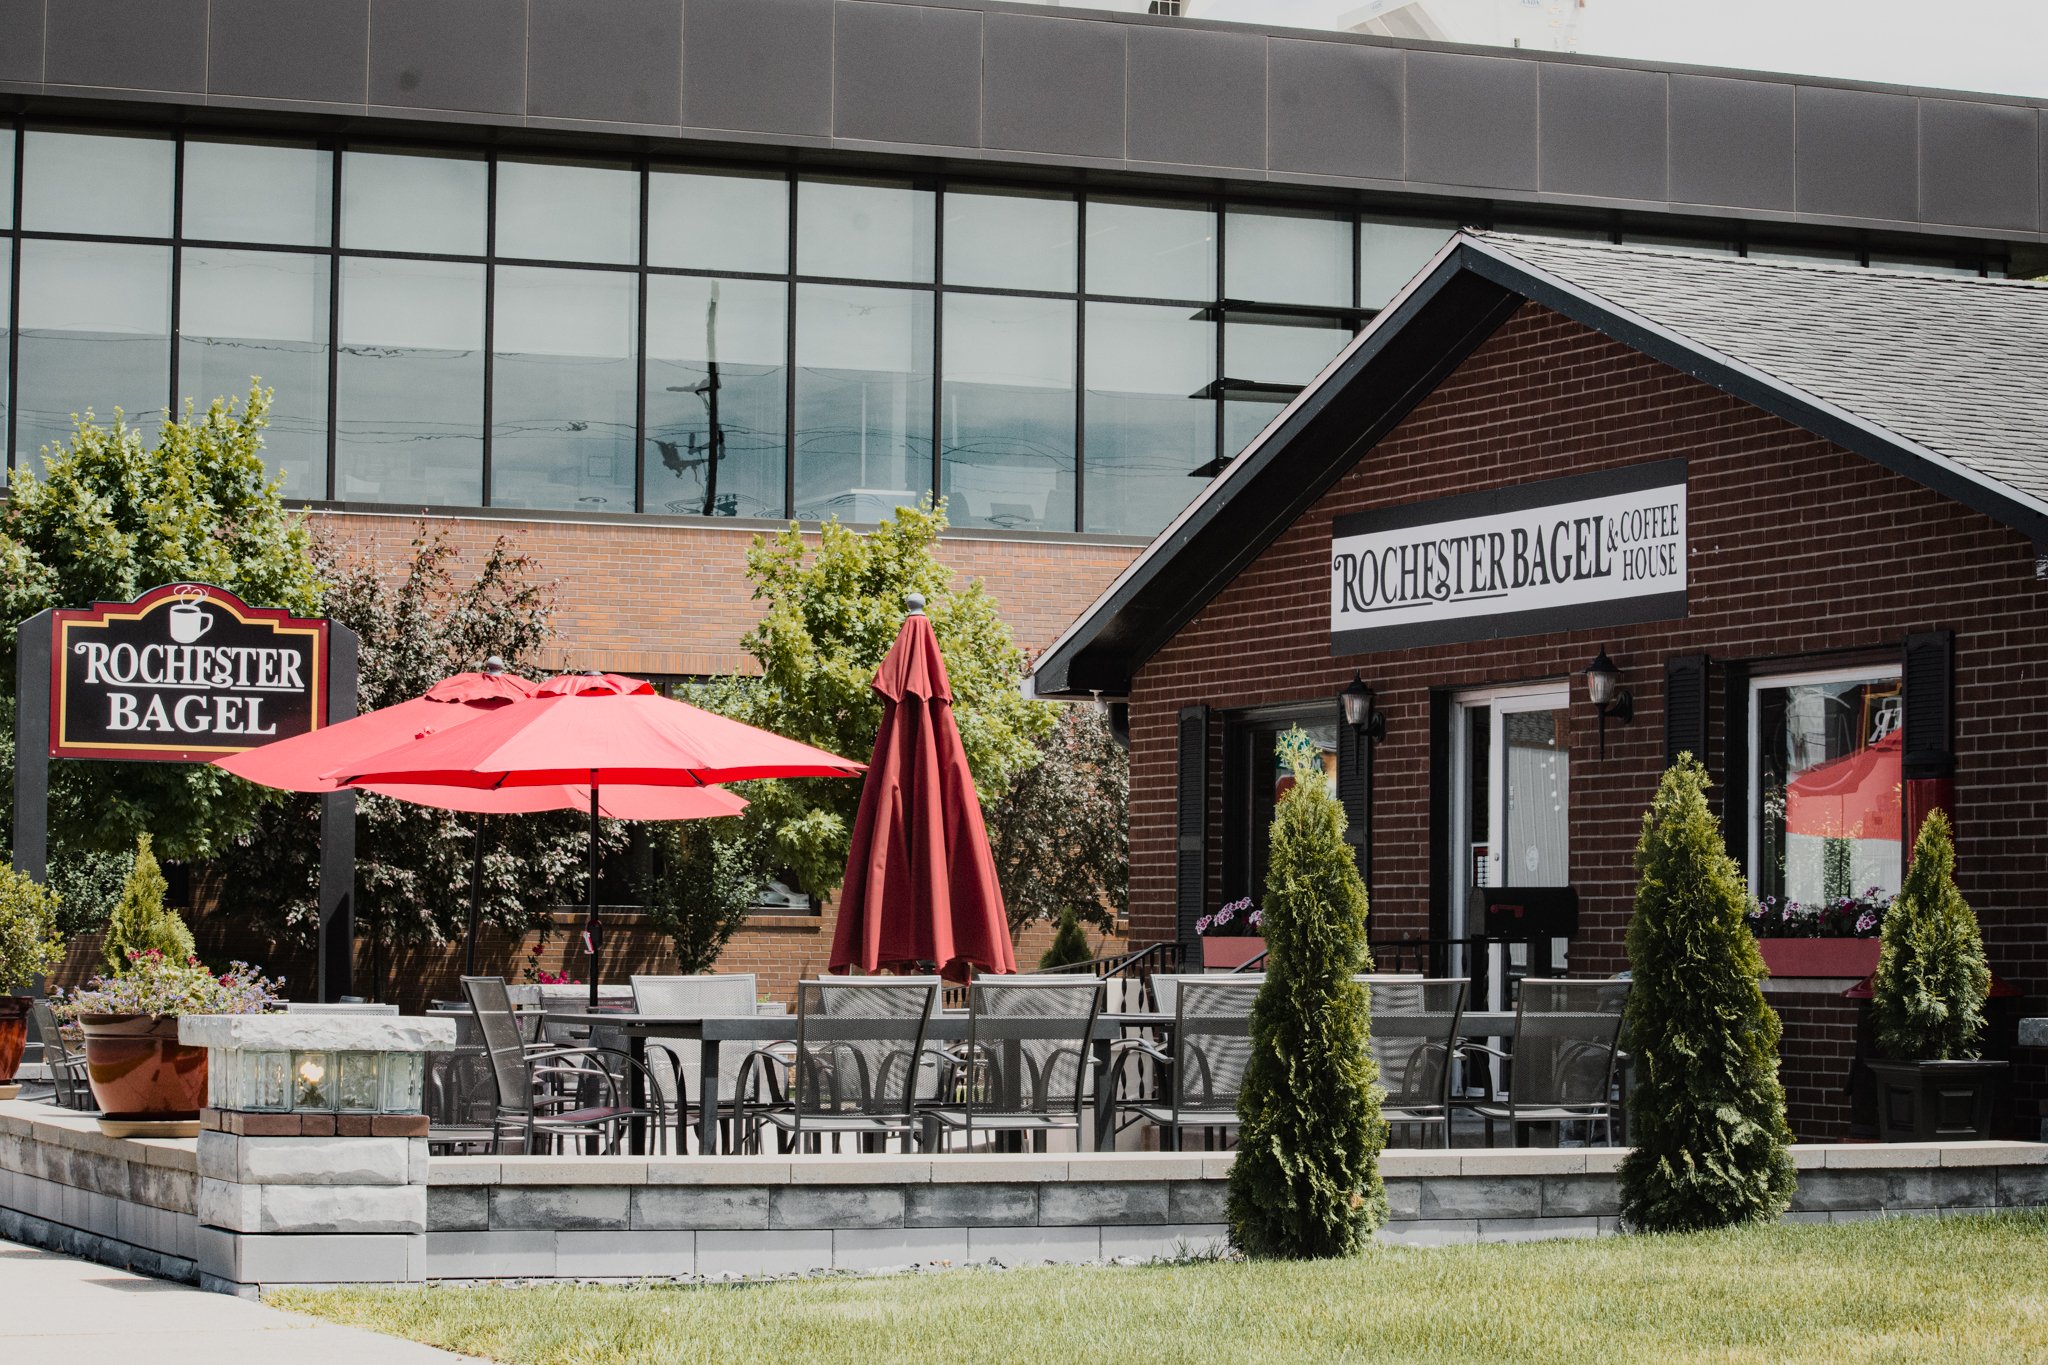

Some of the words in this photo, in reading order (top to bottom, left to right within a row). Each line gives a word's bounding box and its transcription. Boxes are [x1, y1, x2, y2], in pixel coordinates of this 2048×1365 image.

[1620, 503, 1679, 543] COFFEE
[1334, 532, 1508, 613] ROCHESTER
[1510, 515, 1612, 588] BAGEL
[1606, 518, 1619, 552] &
[1622, 543, 1677, 581] HOUSE
[74, 641, 305, 692] ROCHESTER
[106, 692, 276, 735] BAGEL
